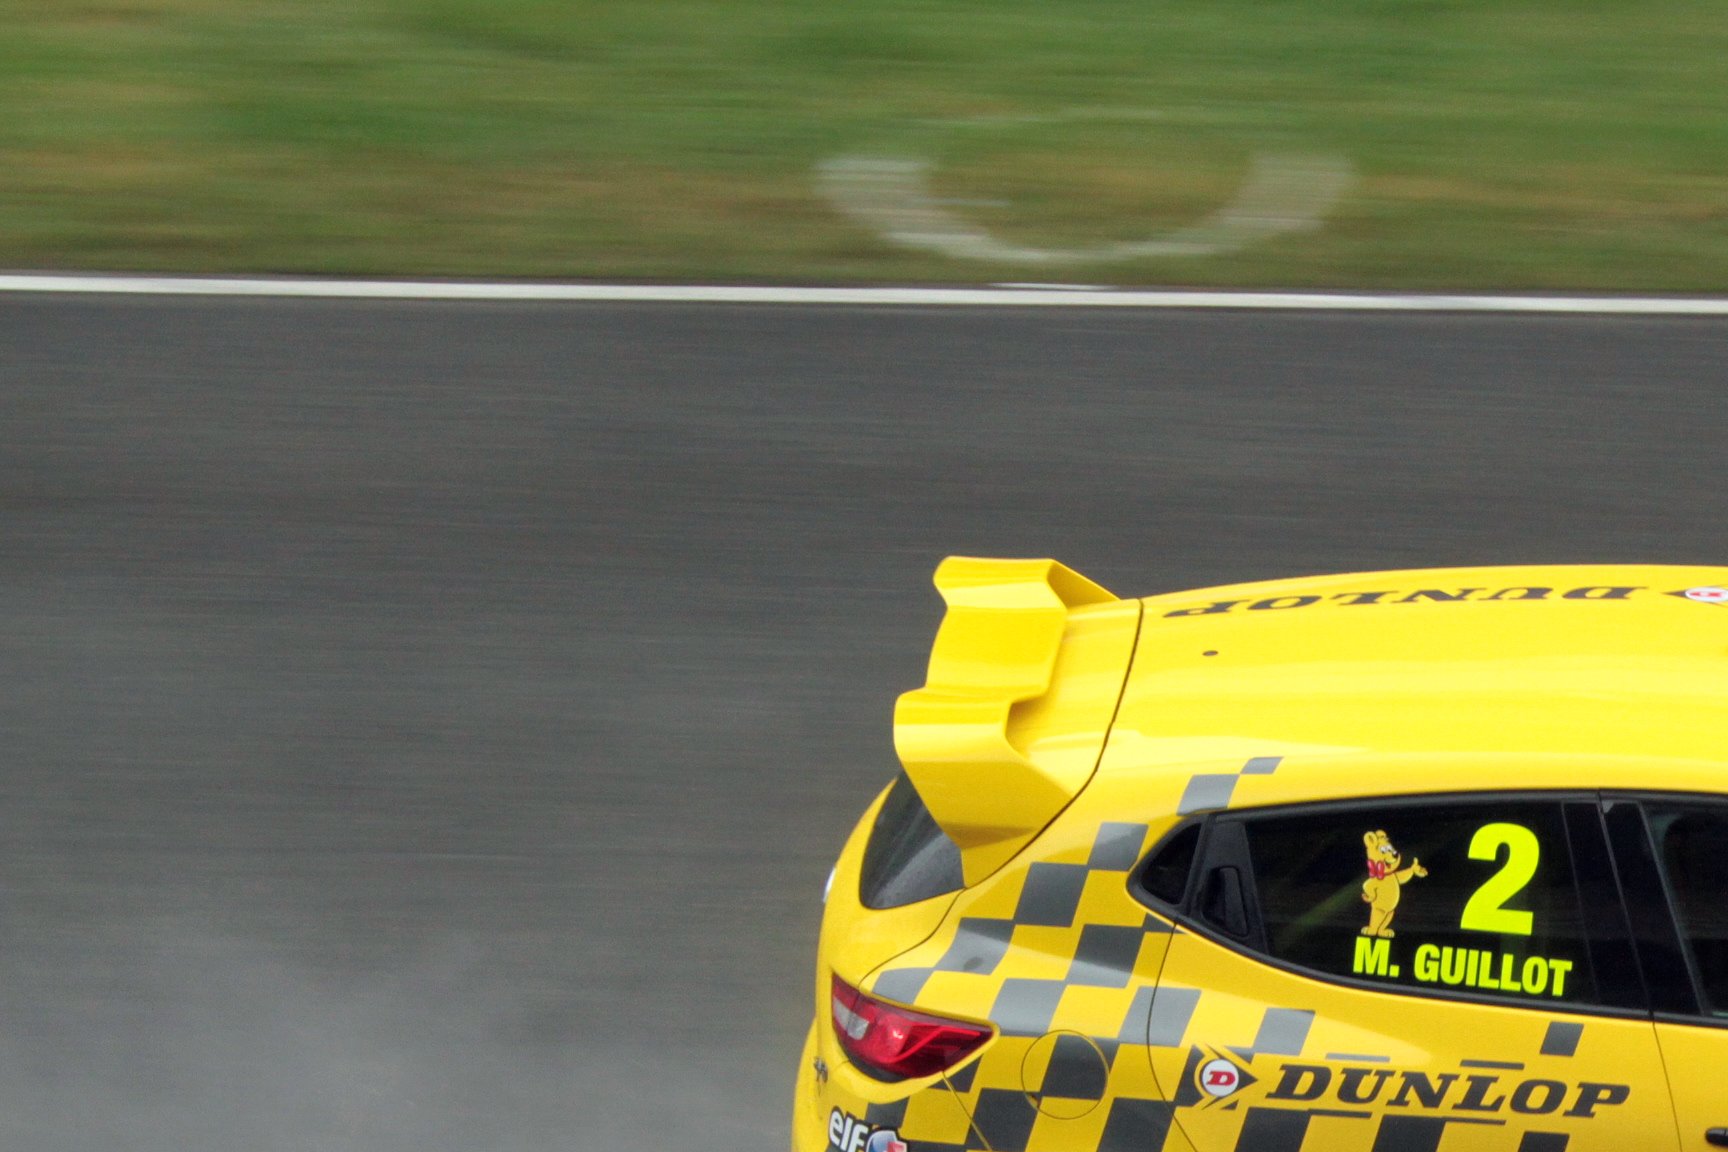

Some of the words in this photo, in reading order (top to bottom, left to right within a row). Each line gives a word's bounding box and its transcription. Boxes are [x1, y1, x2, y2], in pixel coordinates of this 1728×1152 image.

[1163, 586, 1649, 617] DUNLOP
[1460, 822, 1540, 935] 2
[1353, 936, 1400, 977] M.
[1414, 944, 1573, 996] GUILLOT
[1265, 1063, 1631, 1119] DUNLOP
